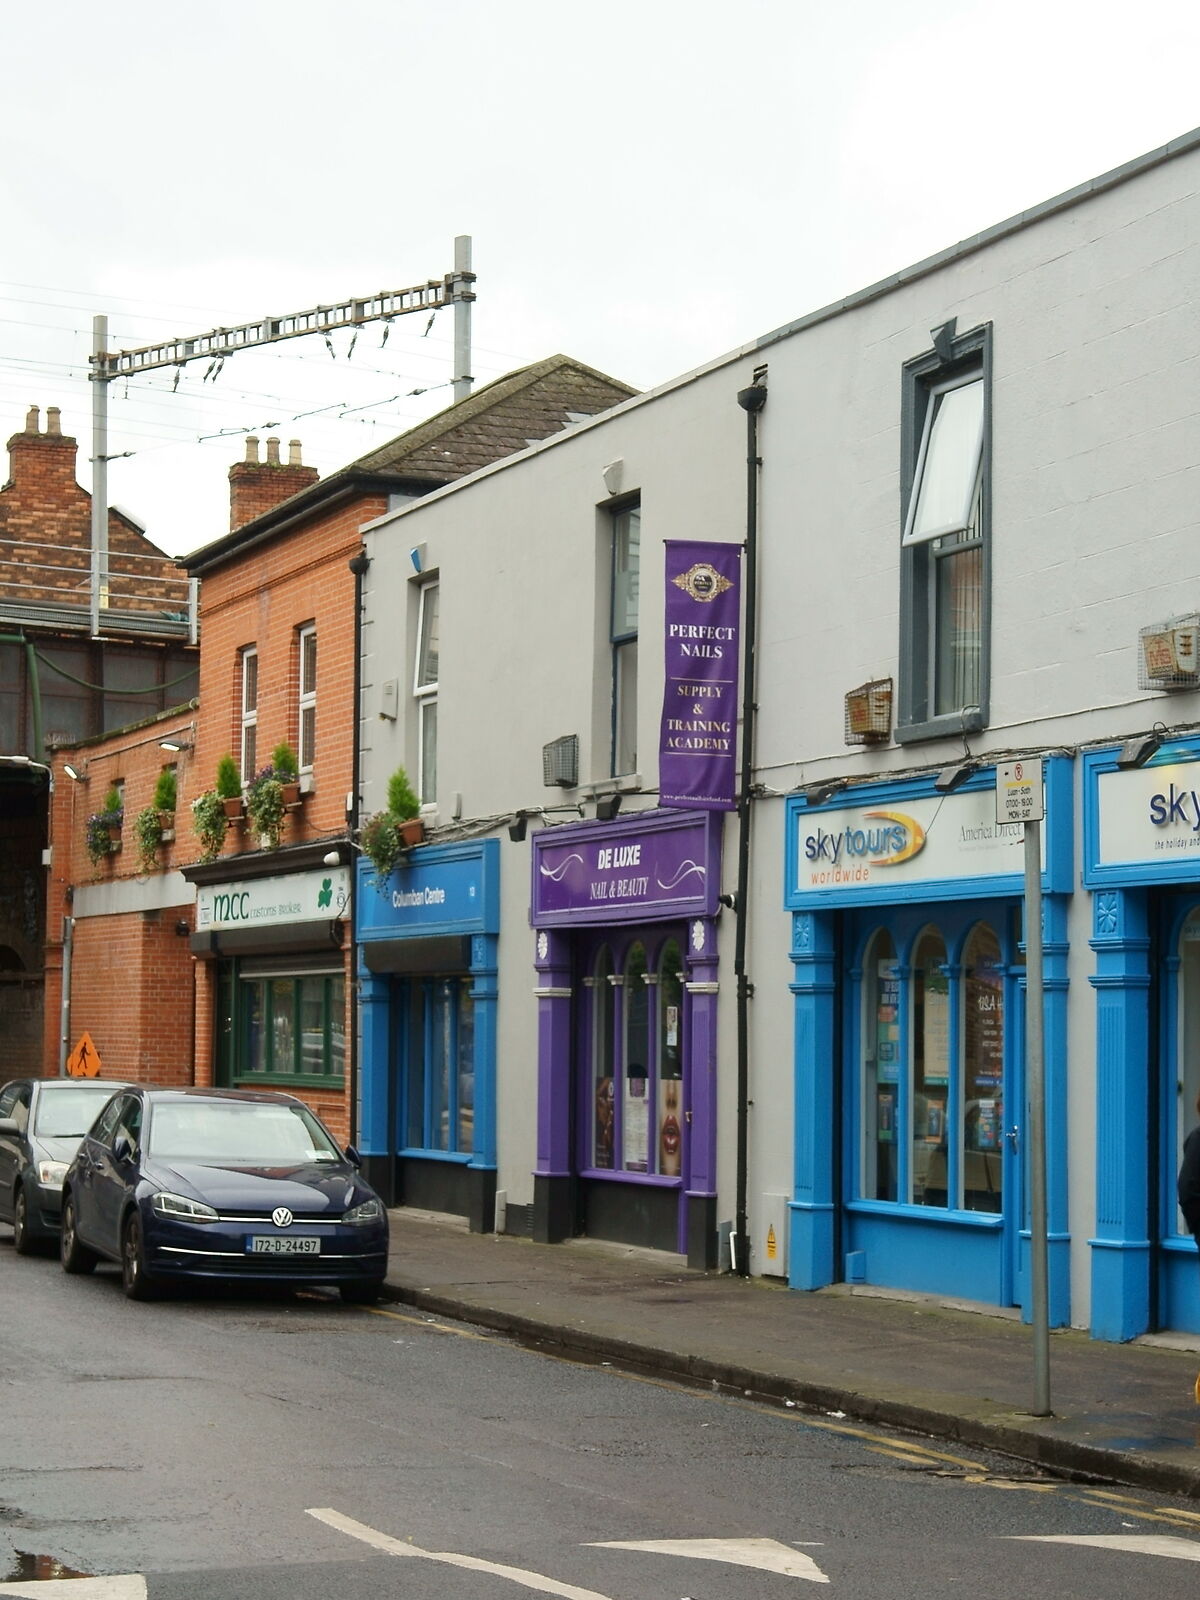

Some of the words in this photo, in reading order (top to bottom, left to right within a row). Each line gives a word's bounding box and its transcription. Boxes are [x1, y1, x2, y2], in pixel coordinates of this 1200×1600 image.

[670, 624, 735, 641] PERFECT
[680, 643, 723, 660] NAILS
[677, 685, 723, 699] SUPPLY
[693, 703, 704, 714] &
[667, 719, 731, 733] TRAINING
[666, 737, 731, 751] ACADEMY
[1155, 840, 1164, 850] the
[1166, 837, 1187, 849] holiday
[1189, 837, 1200, 846] and
[598, 848, 611, 870] DE
[613, 845, 641, 868] LUXE
[811, 866, 869, 885] worldwide
[425, 887, 445, 905] Centre
[590, 881, 608, 900] NAIL
[609, 882, 616, 898] &
[617, 877, 649, 898] BEAUTY
[255, 1240, 317, 1252] 172-D-24497
